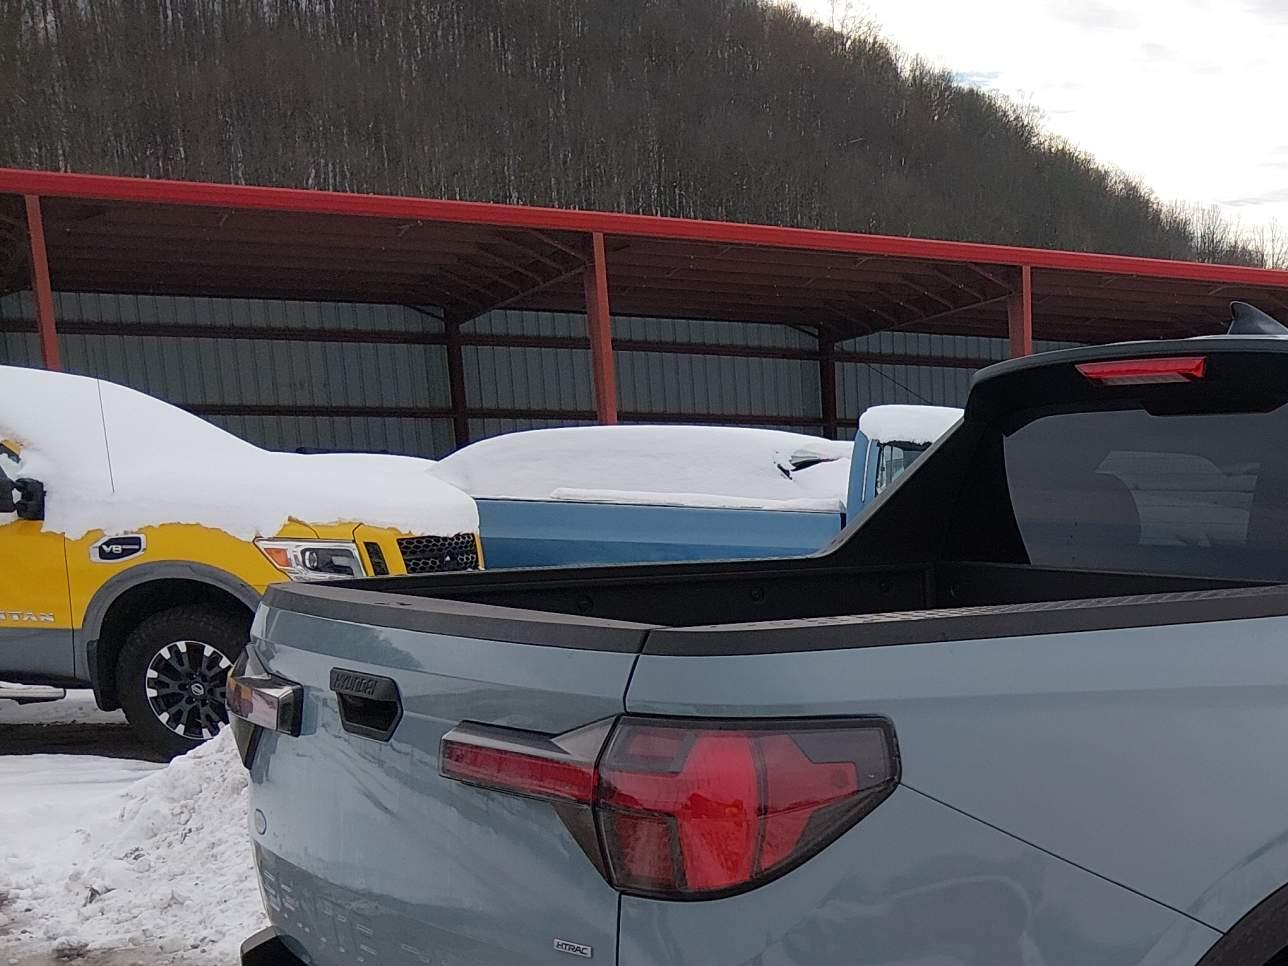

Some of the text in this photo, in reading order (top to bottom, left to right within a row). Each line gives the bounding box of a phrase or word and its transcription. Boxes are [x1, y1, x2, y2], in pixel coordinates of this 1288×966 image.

[101, 544, 123, 554] V8
[332, 672, 378, 697] HYUNDAI
[555, 940, 590, 956] HTRAC
